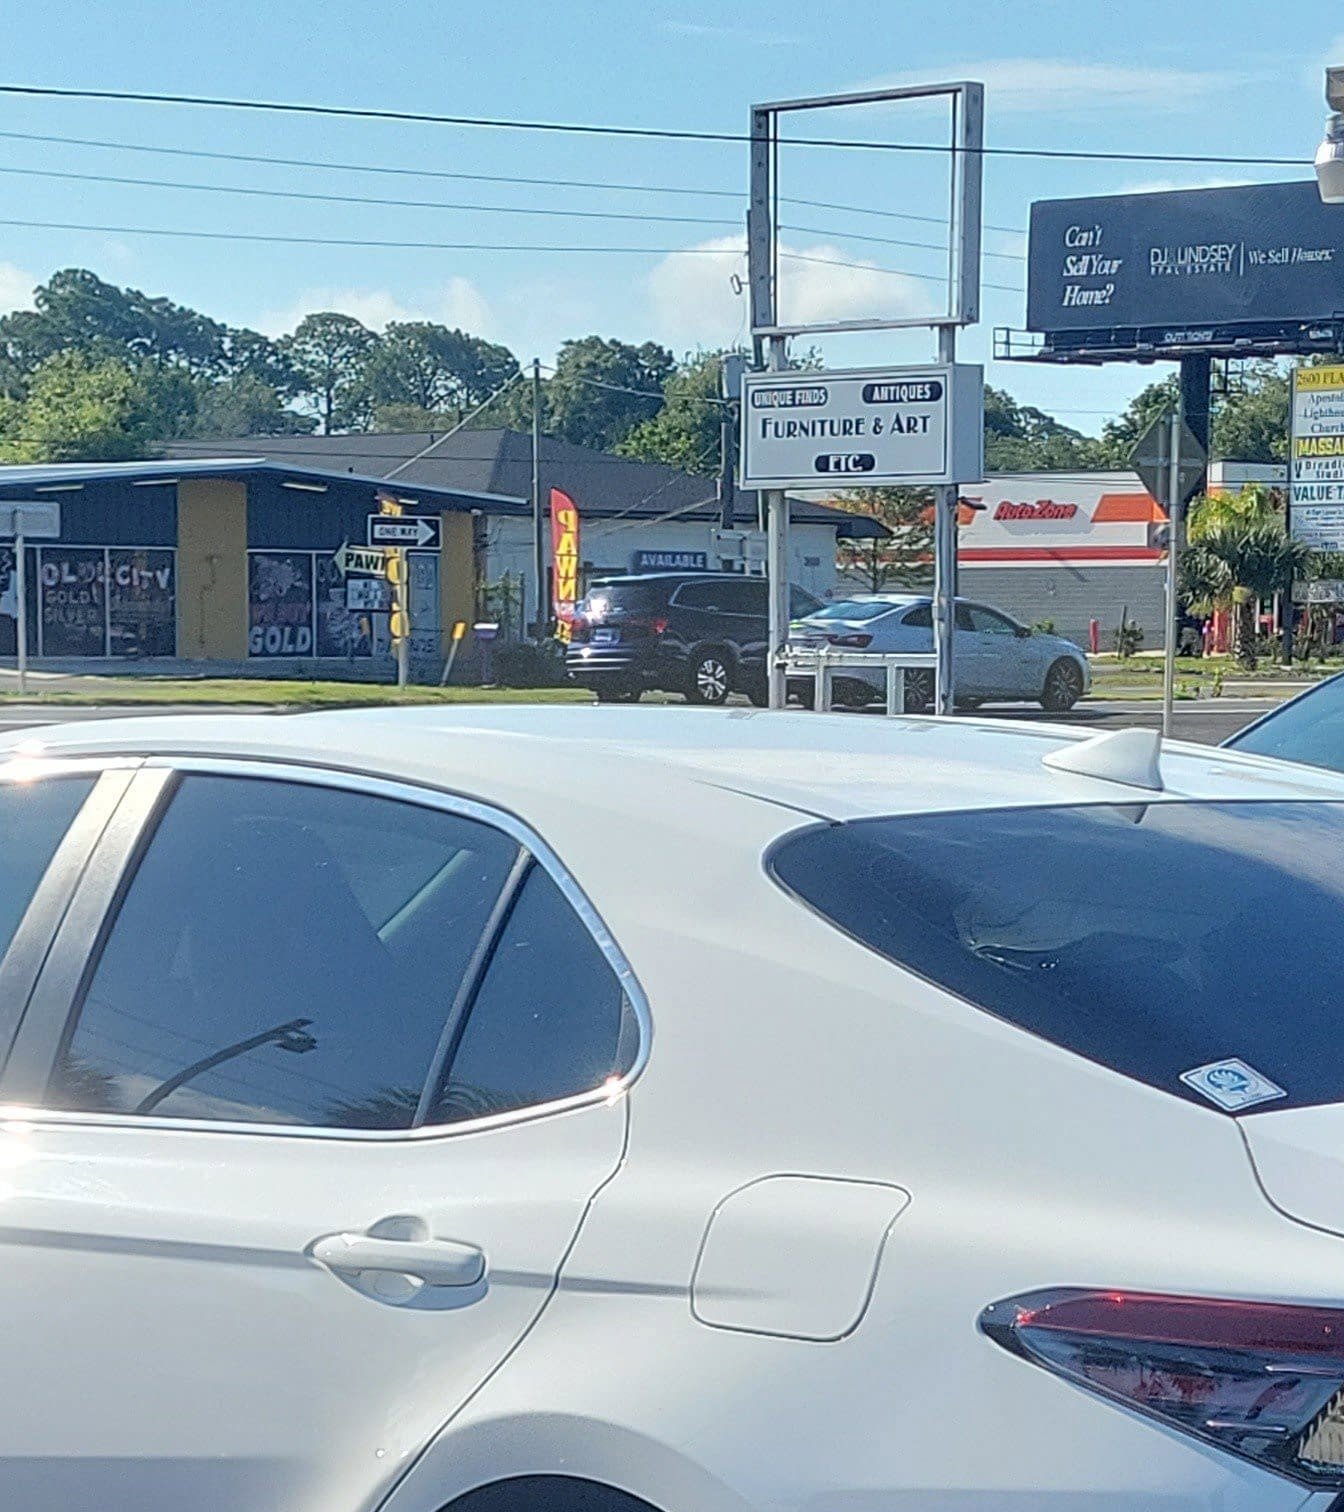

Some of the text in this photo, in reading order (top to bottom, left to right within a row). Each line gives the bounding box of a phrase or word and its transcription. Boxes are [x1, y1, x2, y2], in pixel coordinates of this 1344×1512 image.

[1065, 225, 1103, 247] Can't
[1150, 248, 1167, 266] DJ
[1178, 244, 1236, 264] LINDSEY
[1248, 250, 1266, 265] We
[1268, 248, 1289, 264] Sell
[1063, 254, 1122, 277] Sell Your
[1062, 284, 1115, 306] Home?
[755, 389, 826, 407] UNIQUE FINDS
[872, 384, 931, 402] ANTIQUES
[761, 412, 931, 439] FURNITURE & ART
[828, 455, 863, 472] ETC.
[1294, 485, 1333, 501] VALUE
[994, 500, 1078, 520] AutoZone
[379, 526, 397, 537] ONE
[640, 554, 704, 568] AVAILABLE
[249, 626, 311, 654] GOLD
